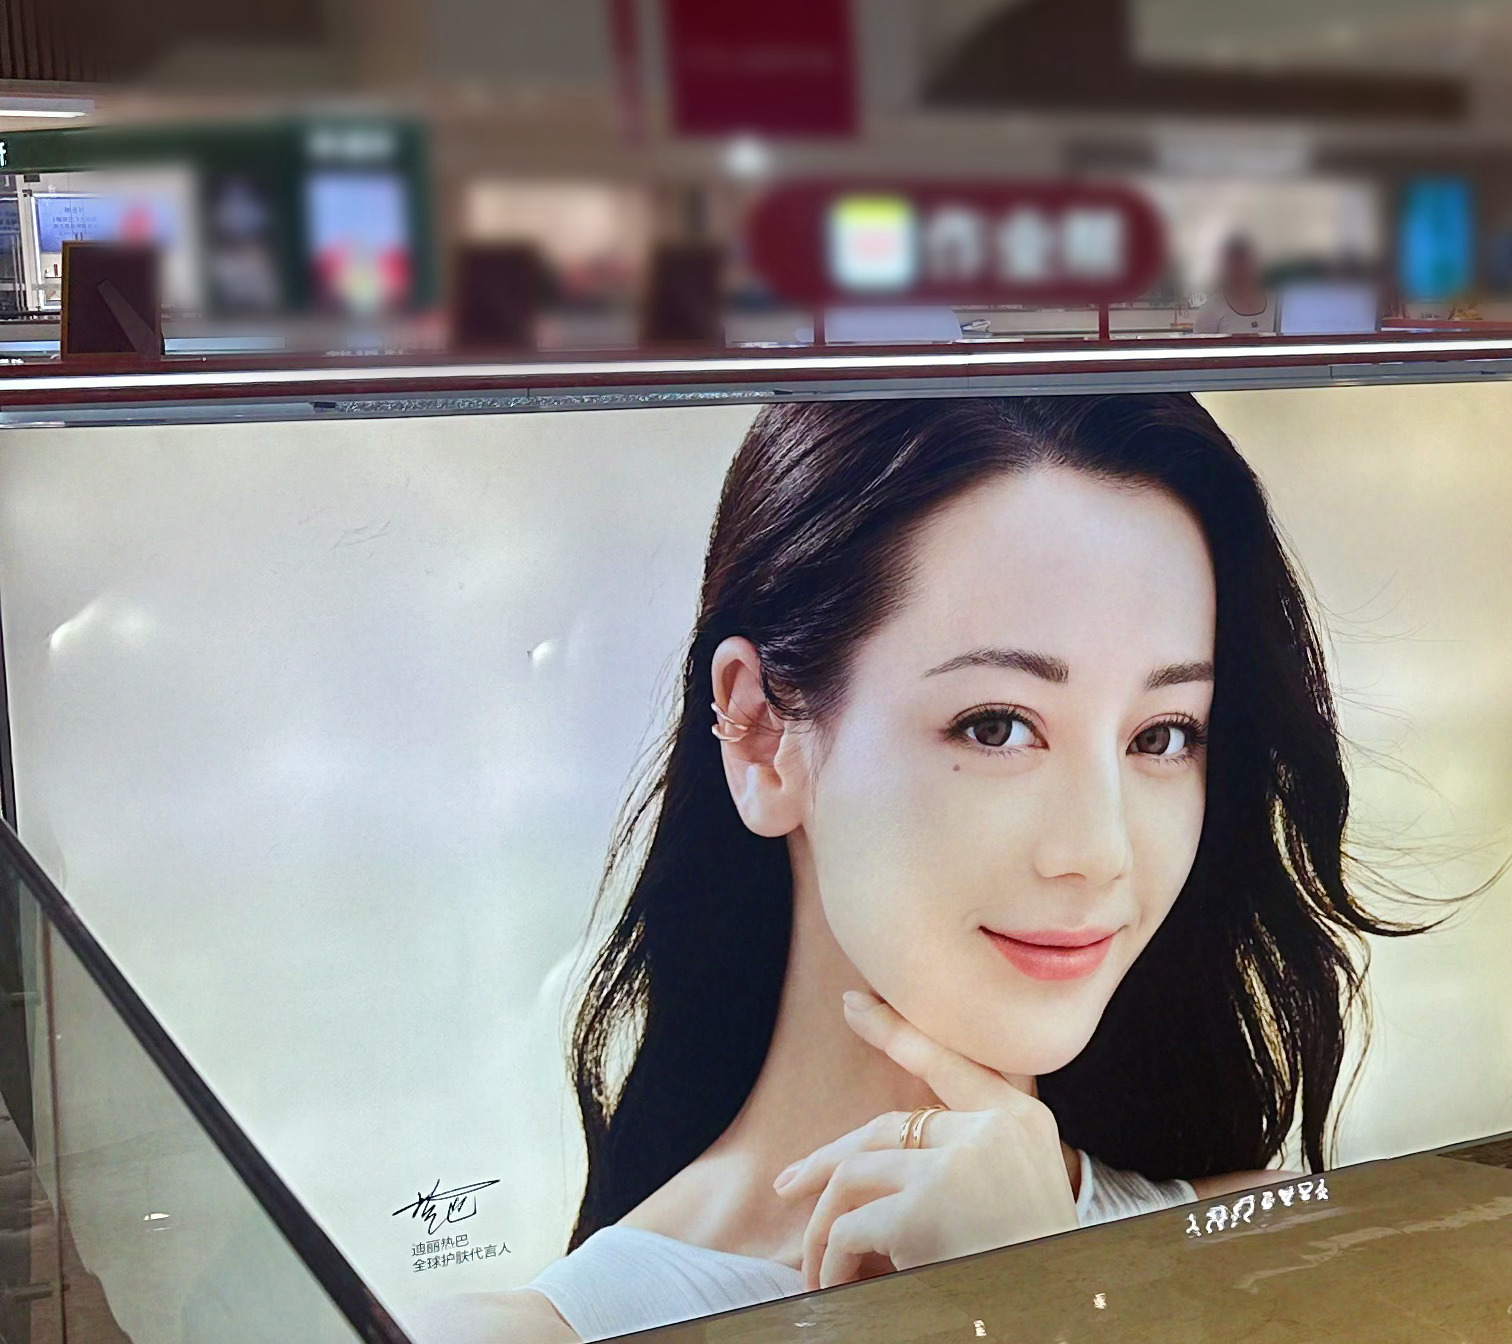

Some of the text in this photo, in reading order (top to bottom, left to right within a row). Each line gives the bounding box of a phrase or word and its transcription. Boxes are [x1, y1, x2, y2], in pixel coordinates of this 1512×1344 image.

[411, 1233, 470, 1257] 迪丽热巴
[412, 1242, 512, 1273] 全球护肤代言人
